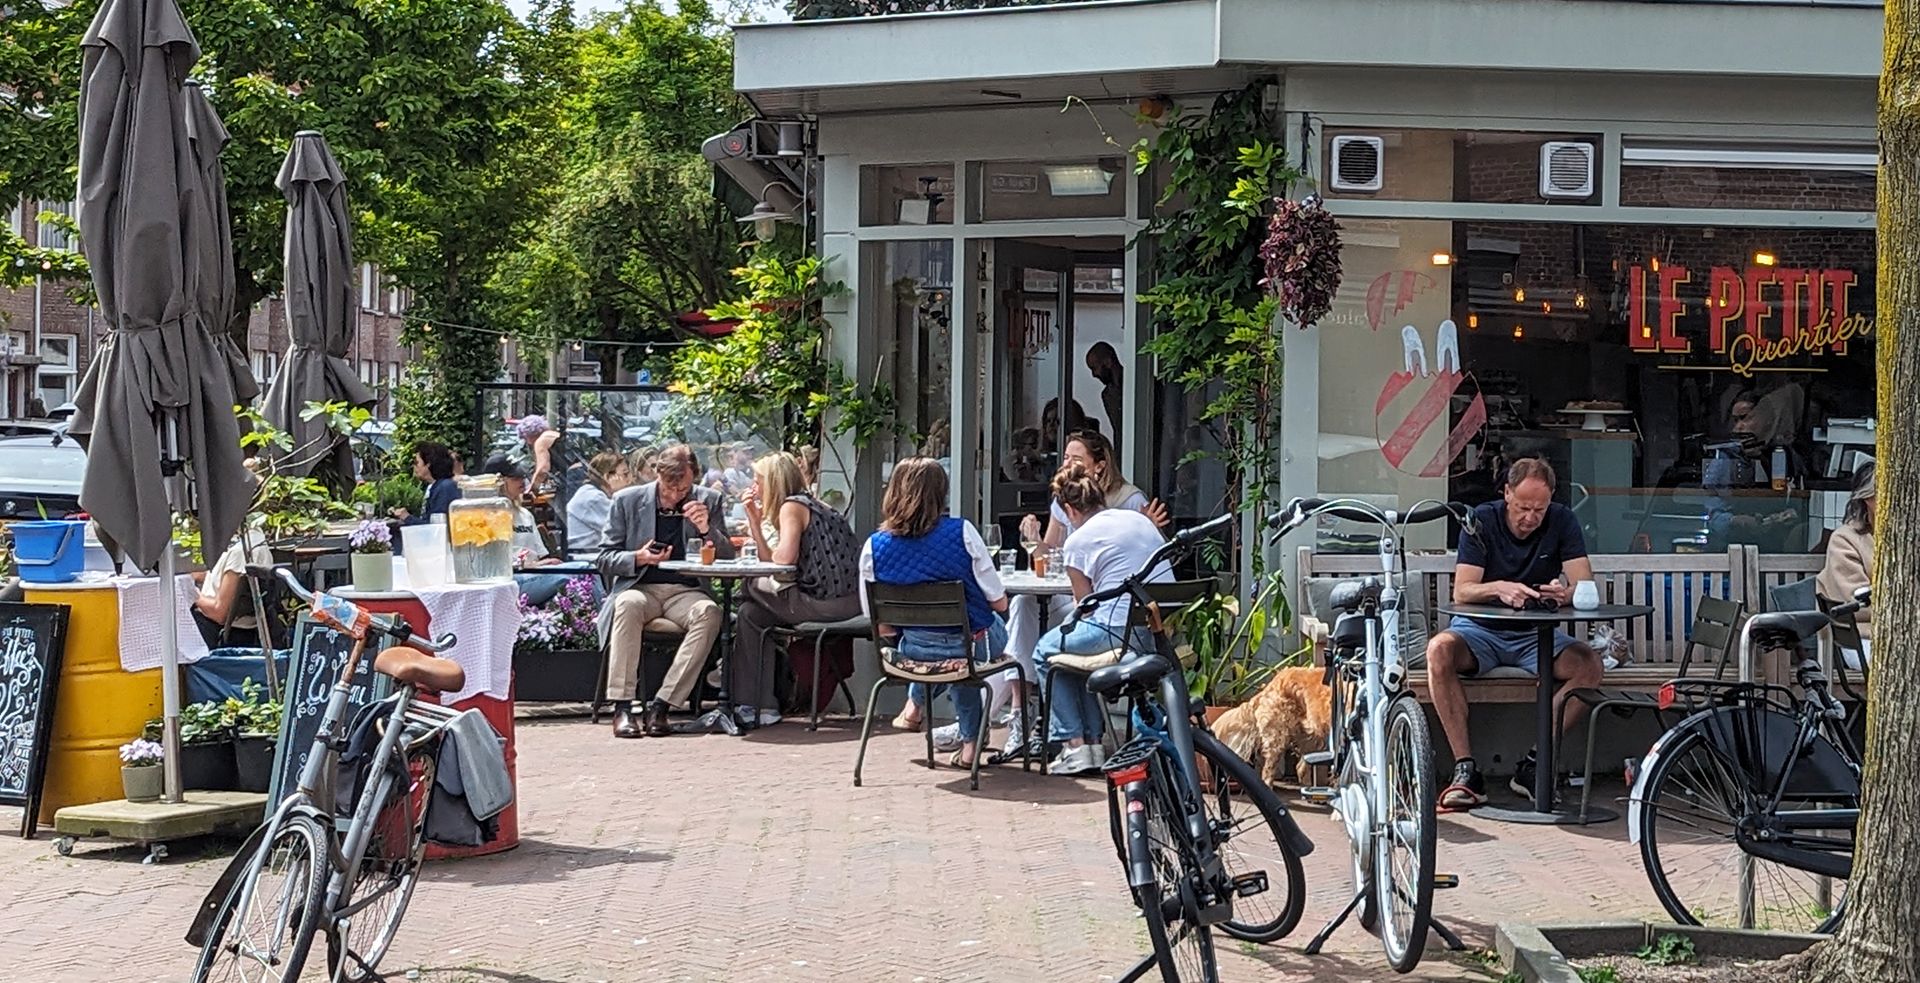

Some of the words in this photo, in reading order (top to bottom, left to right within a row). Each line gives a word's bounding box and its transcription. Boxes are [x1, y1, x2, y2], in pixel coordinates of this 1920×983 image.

[1022, 308, 1052, 349] PETIT
[1629, 265, 1692, 354] LE
[1709, 265, 1859, 356] PETIT
[1729, 307, 1874, 378] Quartier
